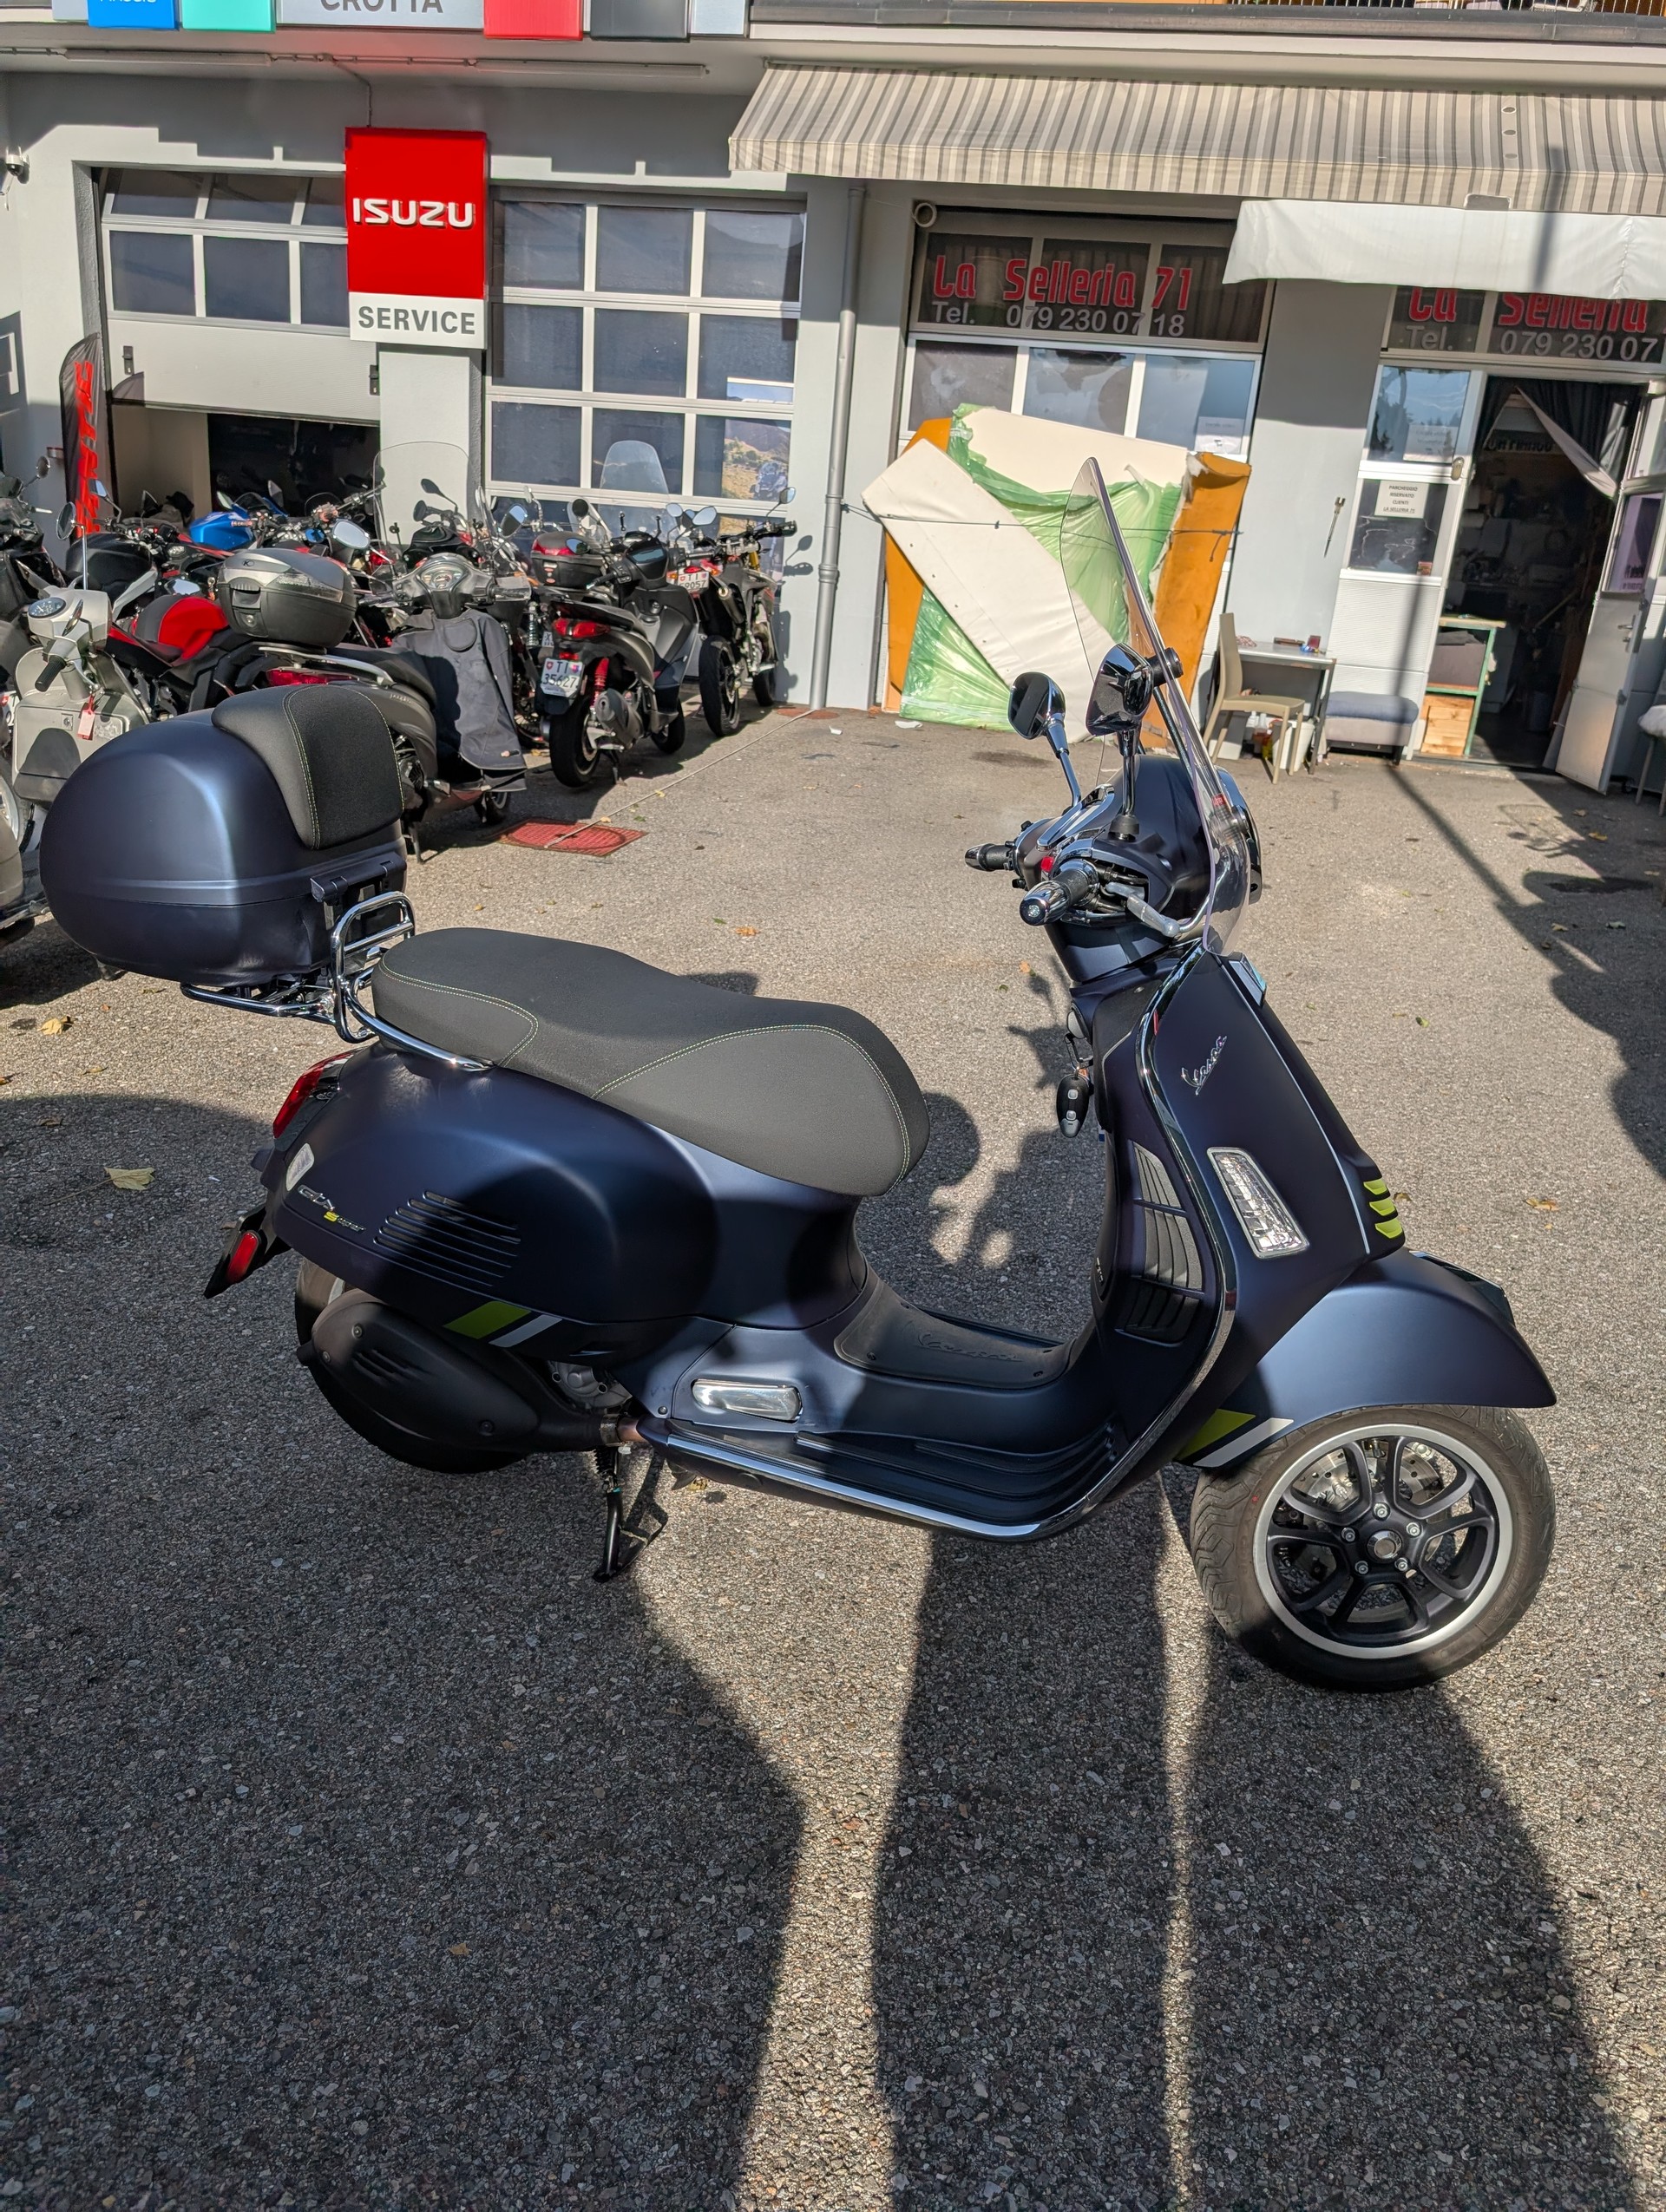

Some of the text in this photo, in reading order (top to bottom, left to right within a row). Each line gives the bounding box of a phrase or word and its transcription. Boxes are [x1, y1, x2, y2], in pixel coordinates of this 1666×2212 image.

[352, 198, 474, 228] ISUZU
[933, 255, 1193, 311] La Selleria 71
[358, 306, 476, 335] SERVICE
[932, 301, 1184, 337] Tel. 079 230 07 18
[1406, 325, 1658, 362] Tel. 079 230 07
[557, 661, 569, 674] TI
[1181, 1036, 1227, 1096] Vespa
